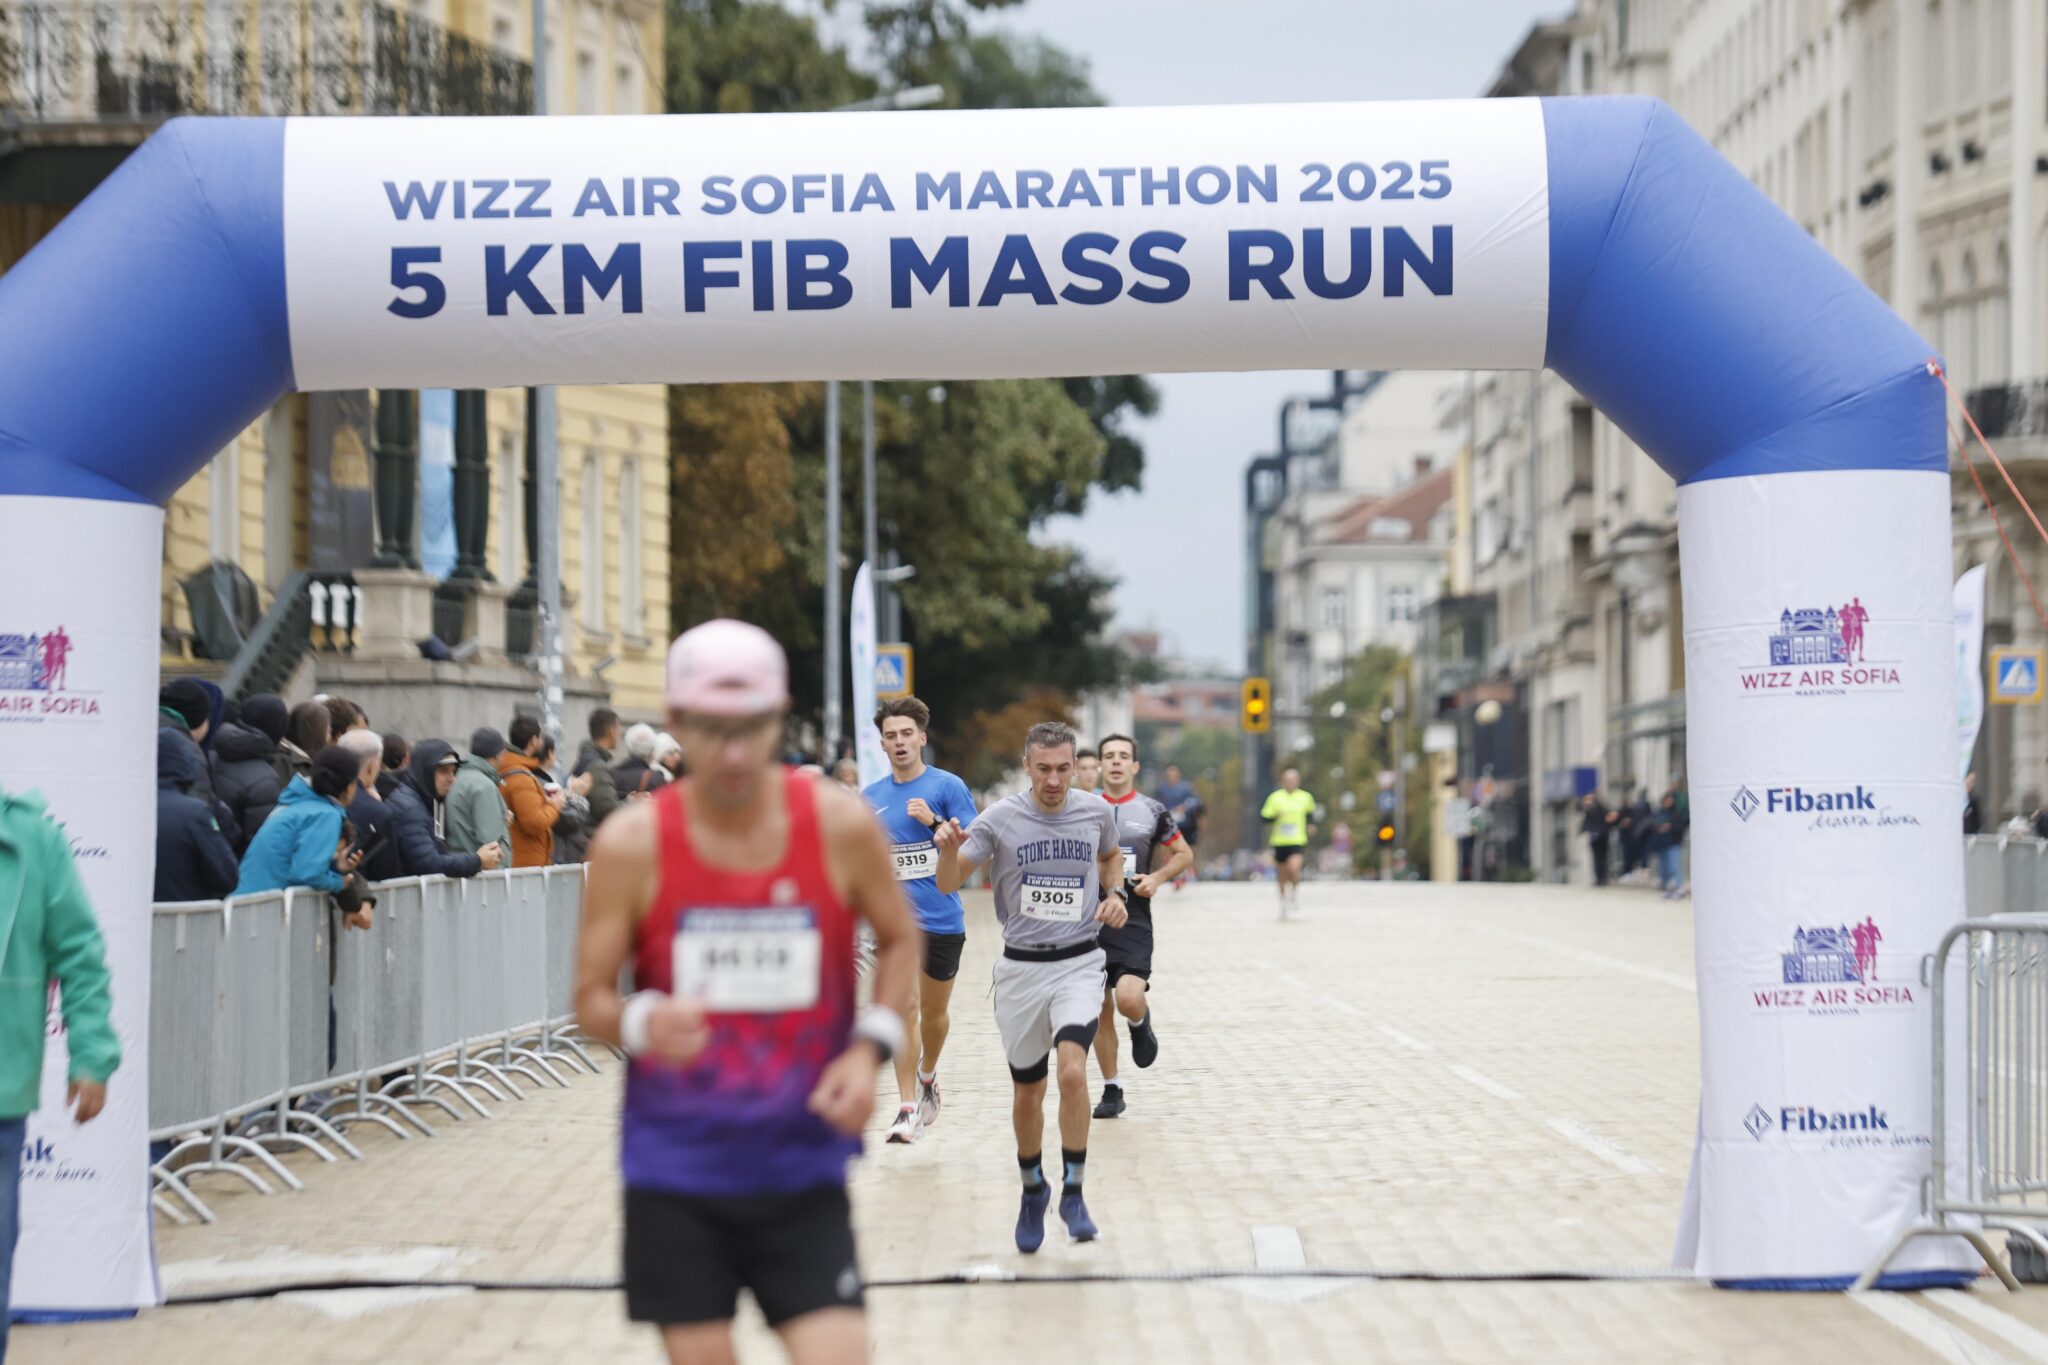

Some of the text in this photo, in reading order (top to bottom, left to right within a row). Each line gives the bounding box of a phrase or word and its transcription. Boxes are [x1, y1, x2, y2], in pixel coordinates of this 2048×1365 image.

[383, 161, 1453, 220] WIZZ AIR SOFIA MARATHON 2025
[387, 224, 1454, 319] 5 KM FIB MASS RUN
[1741, 668, 1901, 690] WIZZ AIR SOFIA
[40, 697, 99, 715] SOFIA
[1767, 785, 1876, 813] Fibank
[897, 854, 928, 867] 9319
[1017, 839, 1092, 867] STONE HARBOR
[1031, 890, 1074, 905] 9305
[1753, 986, 1914, 1008] WIZZ AIR SOFIA
[1780, 1104, 1889, 1132] Fibank
